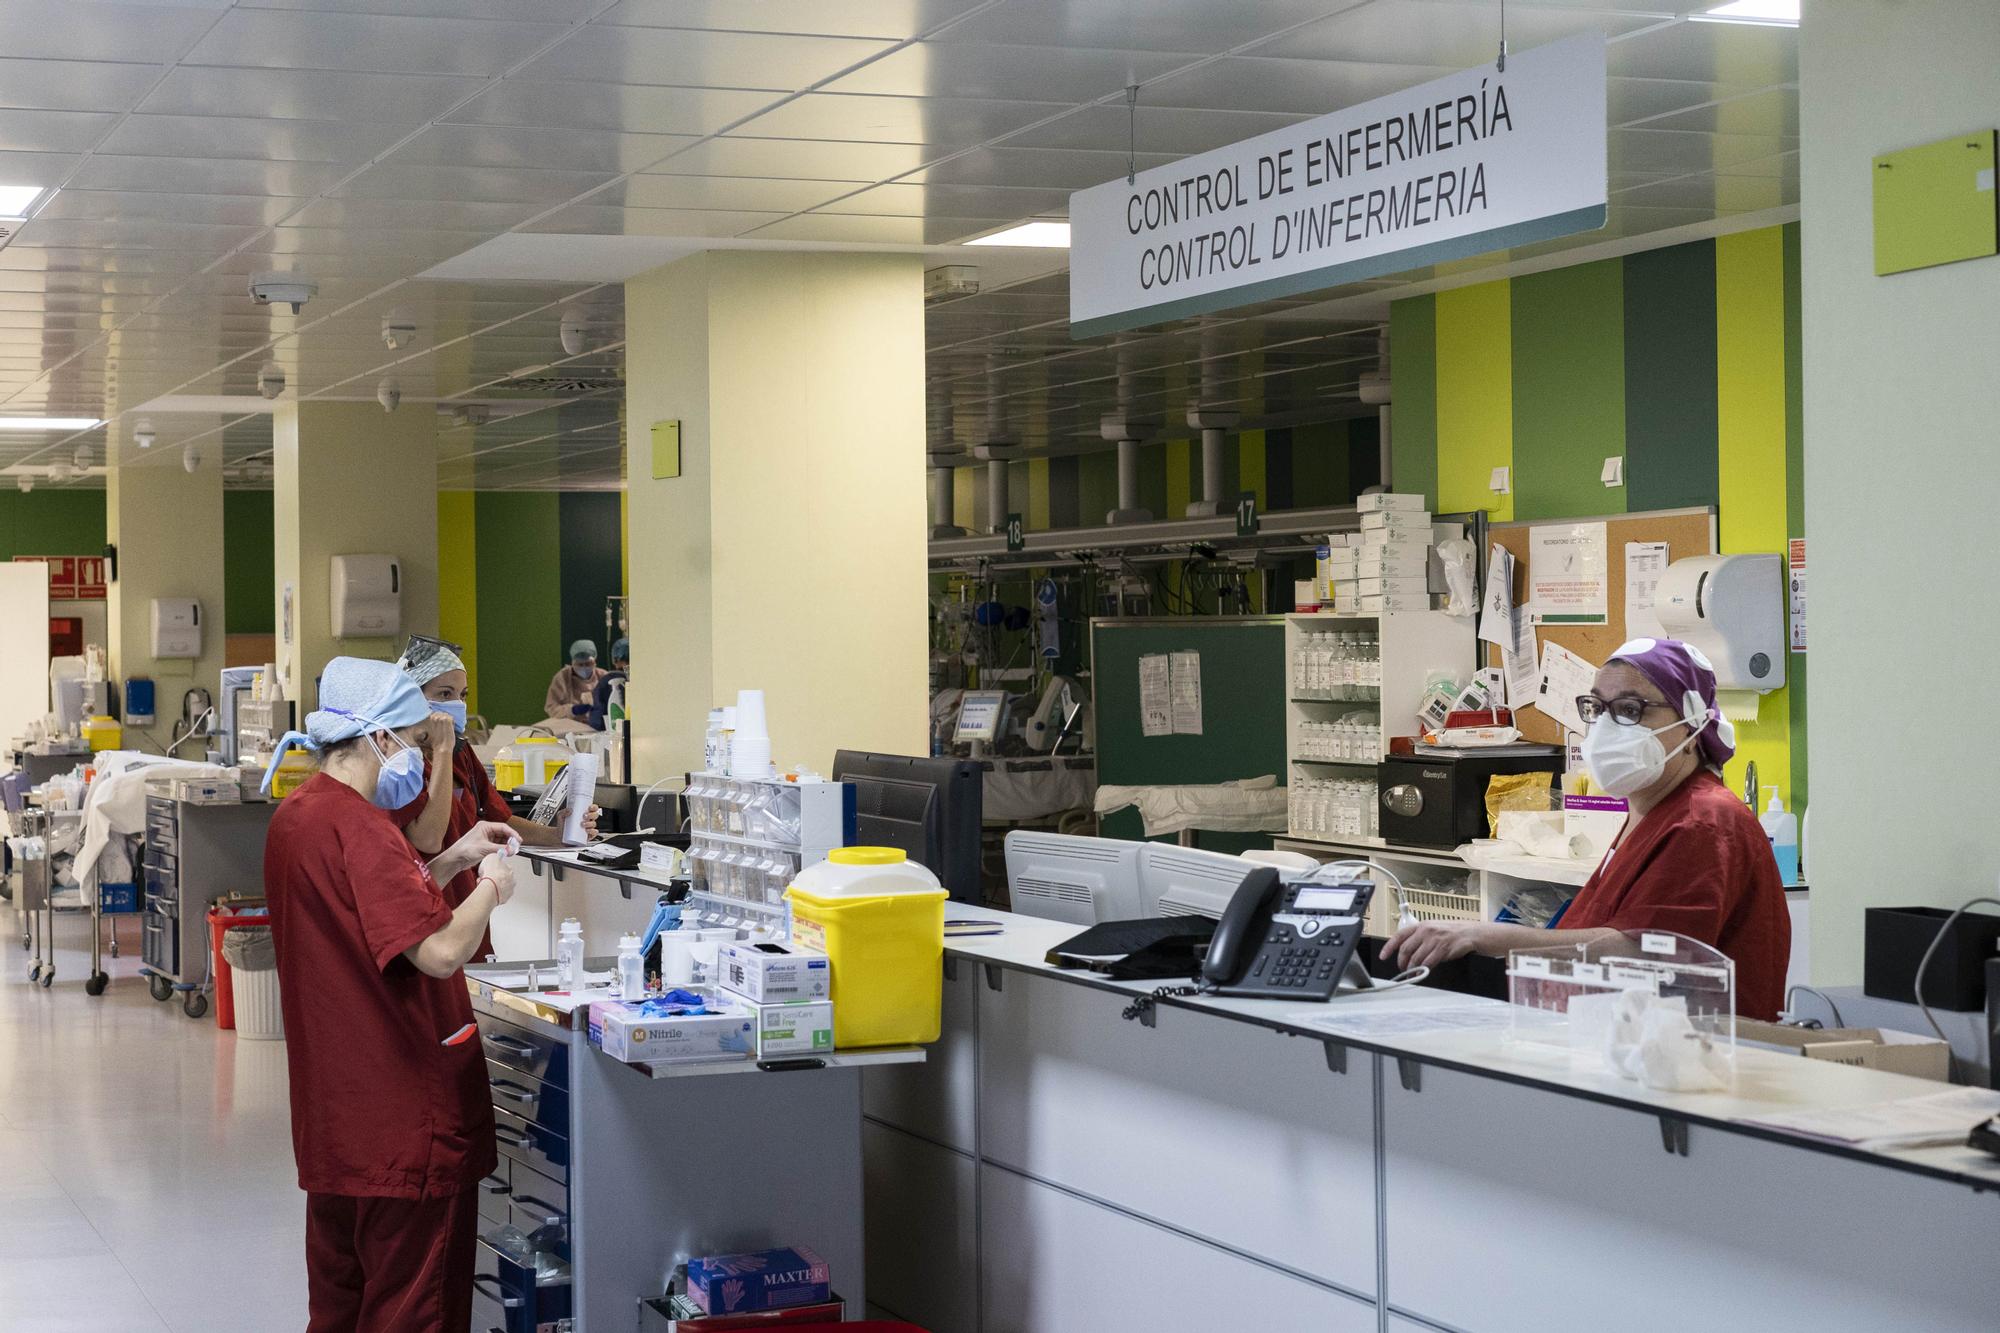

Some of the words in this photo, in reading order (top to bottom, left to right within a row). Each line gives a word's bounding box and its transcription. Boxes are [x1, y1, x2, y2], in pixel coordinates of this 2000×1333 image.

[1128, 165, 1248, 235] CONTROL
[1258, 149, 1294, 201] DE
[1306, 78, 1512, 187] ENFERMERÍA
[1140, 222, 1261, 290] CONTROL
[1272, 162, 1488, 260] D'INFERMERIA
[1237, 499, 1255, 527] 17
[1008, 520, 1021, 544] 18
[635, 1031, 644, 1040] M
[648, 1028, 683, 1040] Nitrile
[818, 1031, 826, 1043] L
[763, 1267, 824, 1287] MAXTER
